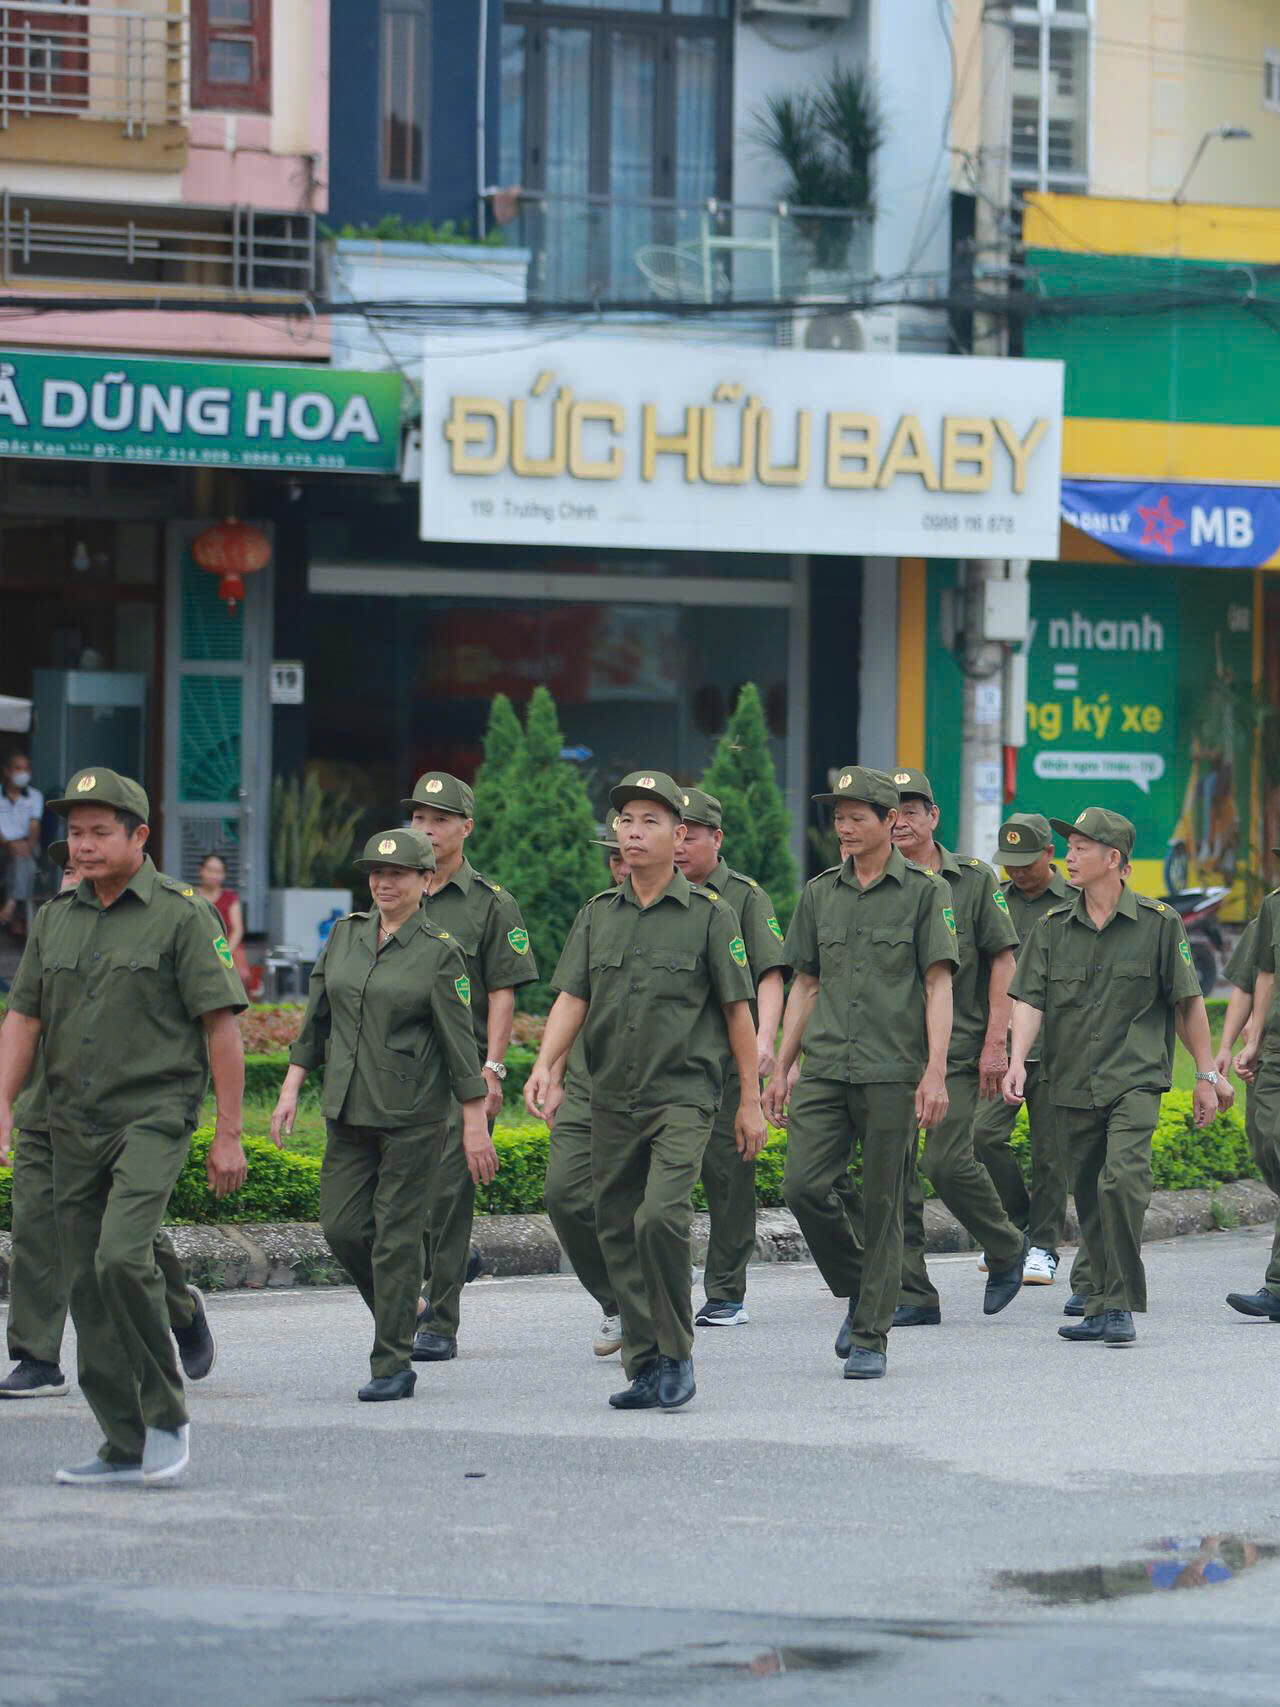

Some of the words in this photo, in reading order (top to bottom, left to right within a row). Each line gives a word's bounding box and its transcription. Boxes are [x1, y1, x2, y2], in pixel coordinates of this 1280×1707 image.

[41, 370, 232, 437] DŨNG
[244, 388, 381, 443] HOA
[445, 370, 624, 481] ĐỨC
[642, 384, 812, 485] HỮU
[827, 411, 1050, 494] BABY
[1190, 506, 1255, 549] MB
[1049, 611, 1164, 652] nhanh
[276, 671, 297, 689] 19
[1072, 693, 1113, 741] ký
[1121, 704, 1164, 734] xe
